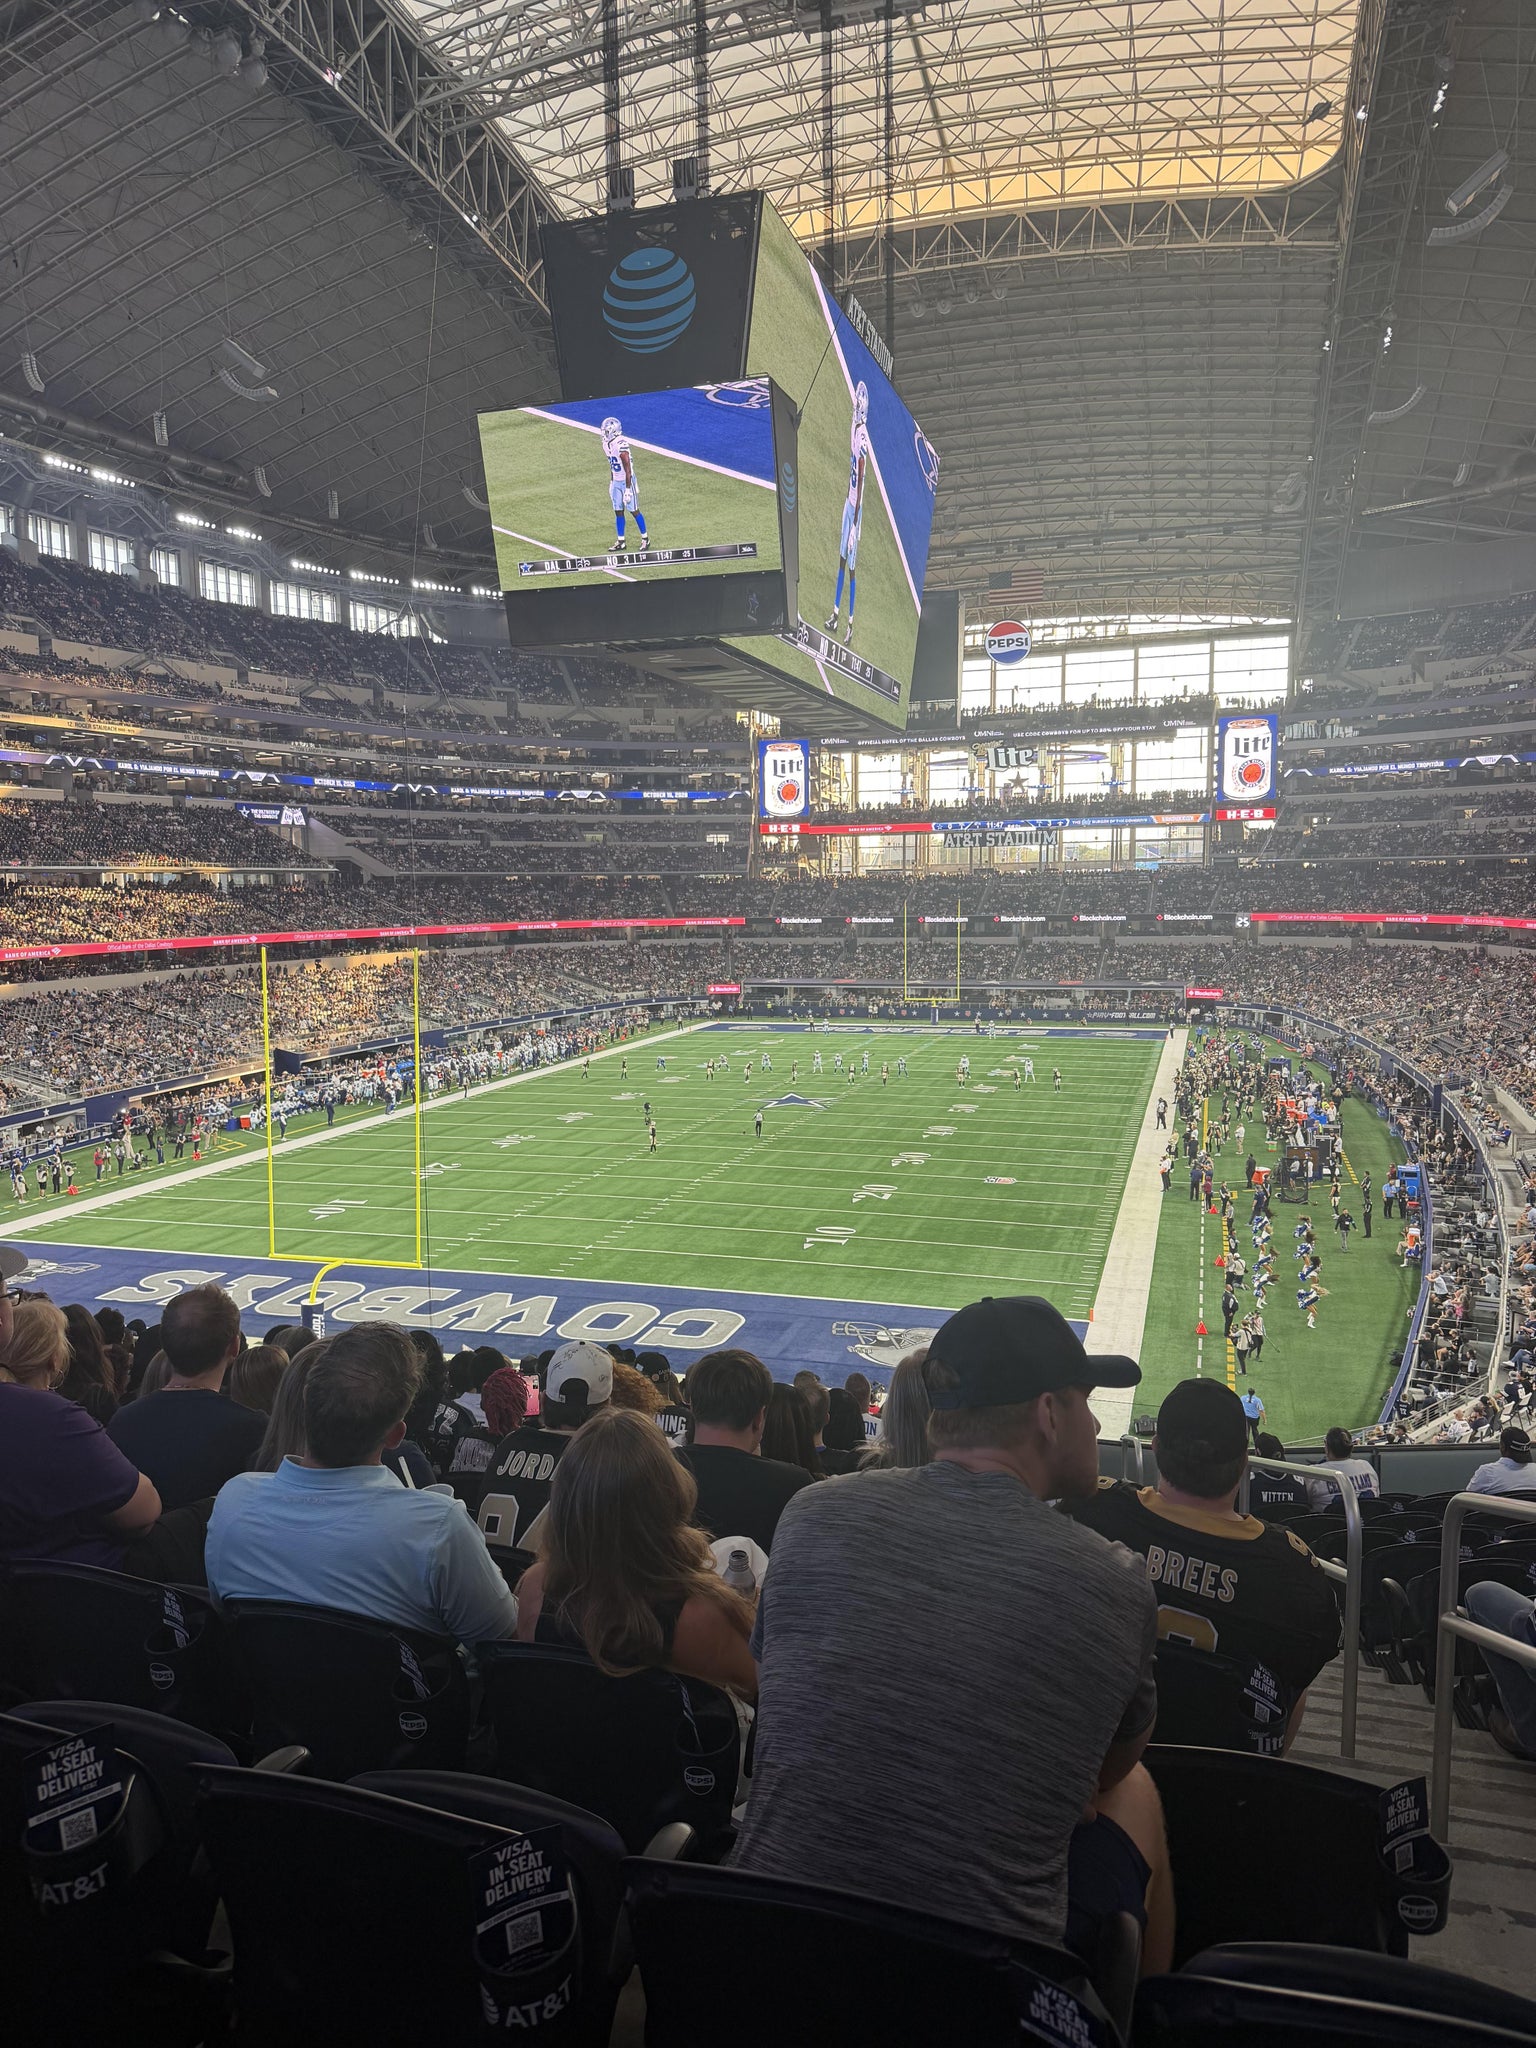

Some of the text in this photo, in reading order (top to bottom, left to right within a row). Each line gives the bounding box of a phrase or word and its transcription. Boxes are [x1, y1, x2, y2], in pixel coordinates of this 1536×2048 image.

[847, 293, 895, 381] AT&T STADIUM
[545, 561, 559, 571] DAL
[566, 560, 571, 569] 0
[607, 555, 618, 566] NO
[624, 555, 630, 565] 3
[656, 551, 673, 560] 11:47
[819, 636, 829, 656] NO
[831, 646, 836, 661] 3
[988, 636, 1029, 649] PEPSI
[1233, 736, 1270, 758] Lite
[773, 758, 803, 778] Lite
[986, 747, 1034, 772] Lite
[944, 830, 1058, 848] AT&T STADIUM
[1079, 914, 1126, 922] Blockchain.com
[1164, 913, 1213, 921] Blockchain.com
[853, 1184, 898, 1200] 20
[806, 1226, 857, 1246] 10
[95, 1269, 746, 1350] COWBOYS
[656, 1414, 687, 1433] NING
[496, 1450, 555, 1482] JORD
[1262, 1491, 1294, 1503] WITTEN
[1147, 1545, 1238, 1602] BREES
[1250, 1677, 1278, 1700] DELIVERY
[48, 1738, 86, 1761] VISA
[41, 1746, 96, 1781] IN-SEAT
[37, 1760, 104, 1802] DELIVERY
[1387, 1795, 1416, 1817] IN-SEAT
[1391, 1786, 1409, 1802] VISA
[1386, 1808, 1420, 1835] DELIVERY
[493, 1839, 533, 1864] VISA
[489, 1851, 544, 1886] IN-SEAT
[40, 1861, 109, 1905] AT&T
[485, 1866, 552, 1907] DELIVERY
[1400, 1904, 1436, 1917] PEPSI
[504, 1973, 572, 2028] AT&T
[1038, 1981, 1079, 2015] VISA
[1033, 1990, 1089, 2037] IN-SEAT
